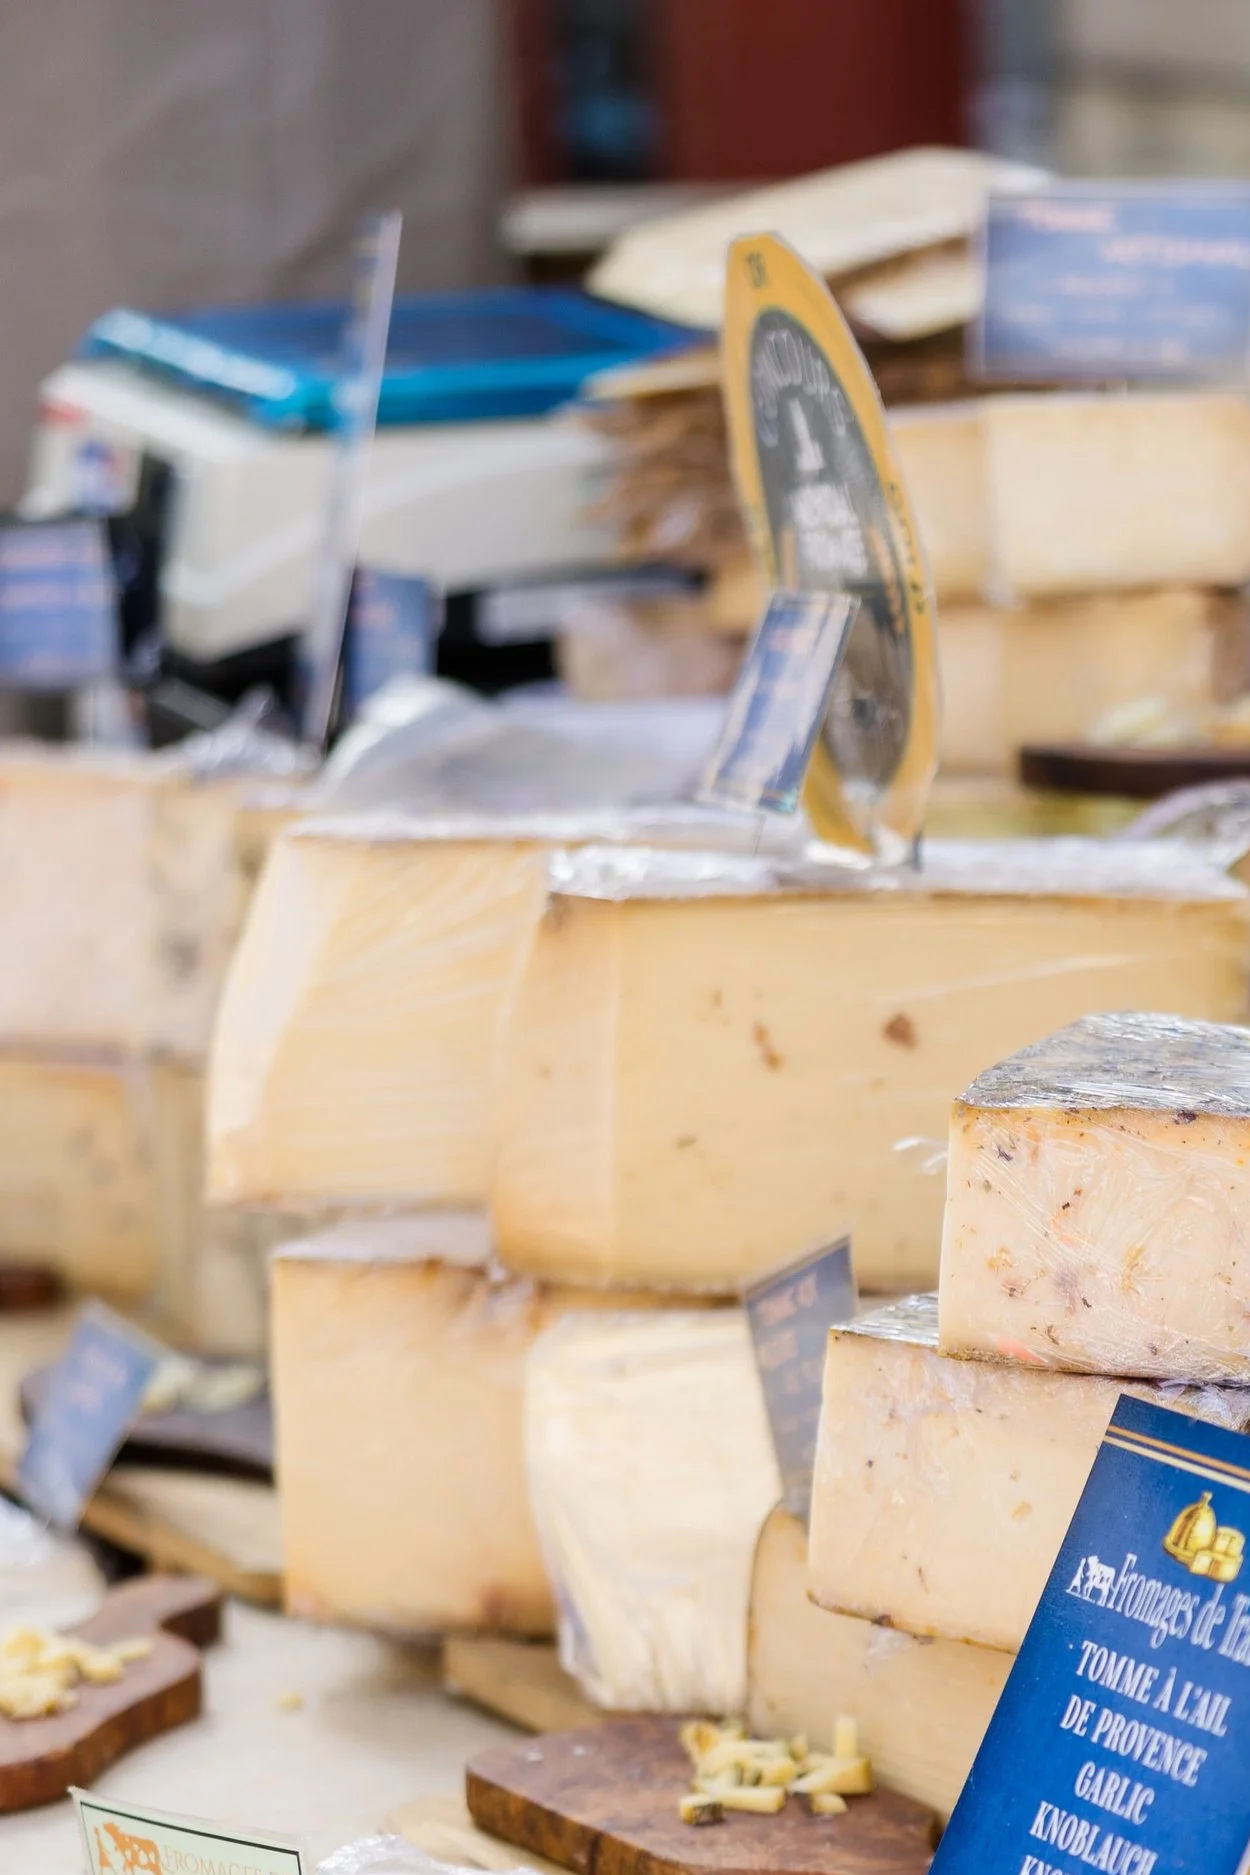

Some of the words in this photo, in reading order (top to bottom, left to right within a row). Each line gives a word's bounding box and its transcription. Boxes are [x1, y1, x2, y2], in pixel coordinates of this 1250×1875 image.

[1112, 1552, 1201, 1650] Fromages
[1190, 1583, 1226, 1650] de
[1075, 1639, 1160, 1705] TOMME
[1152, 1666, 1178, 1713] À
[1059, 1694, 1097, 1738] DE
[1090, 1707, 1208, 1787] PROVENCE
[1074, 1760, 1155, 1826] GARLIC
